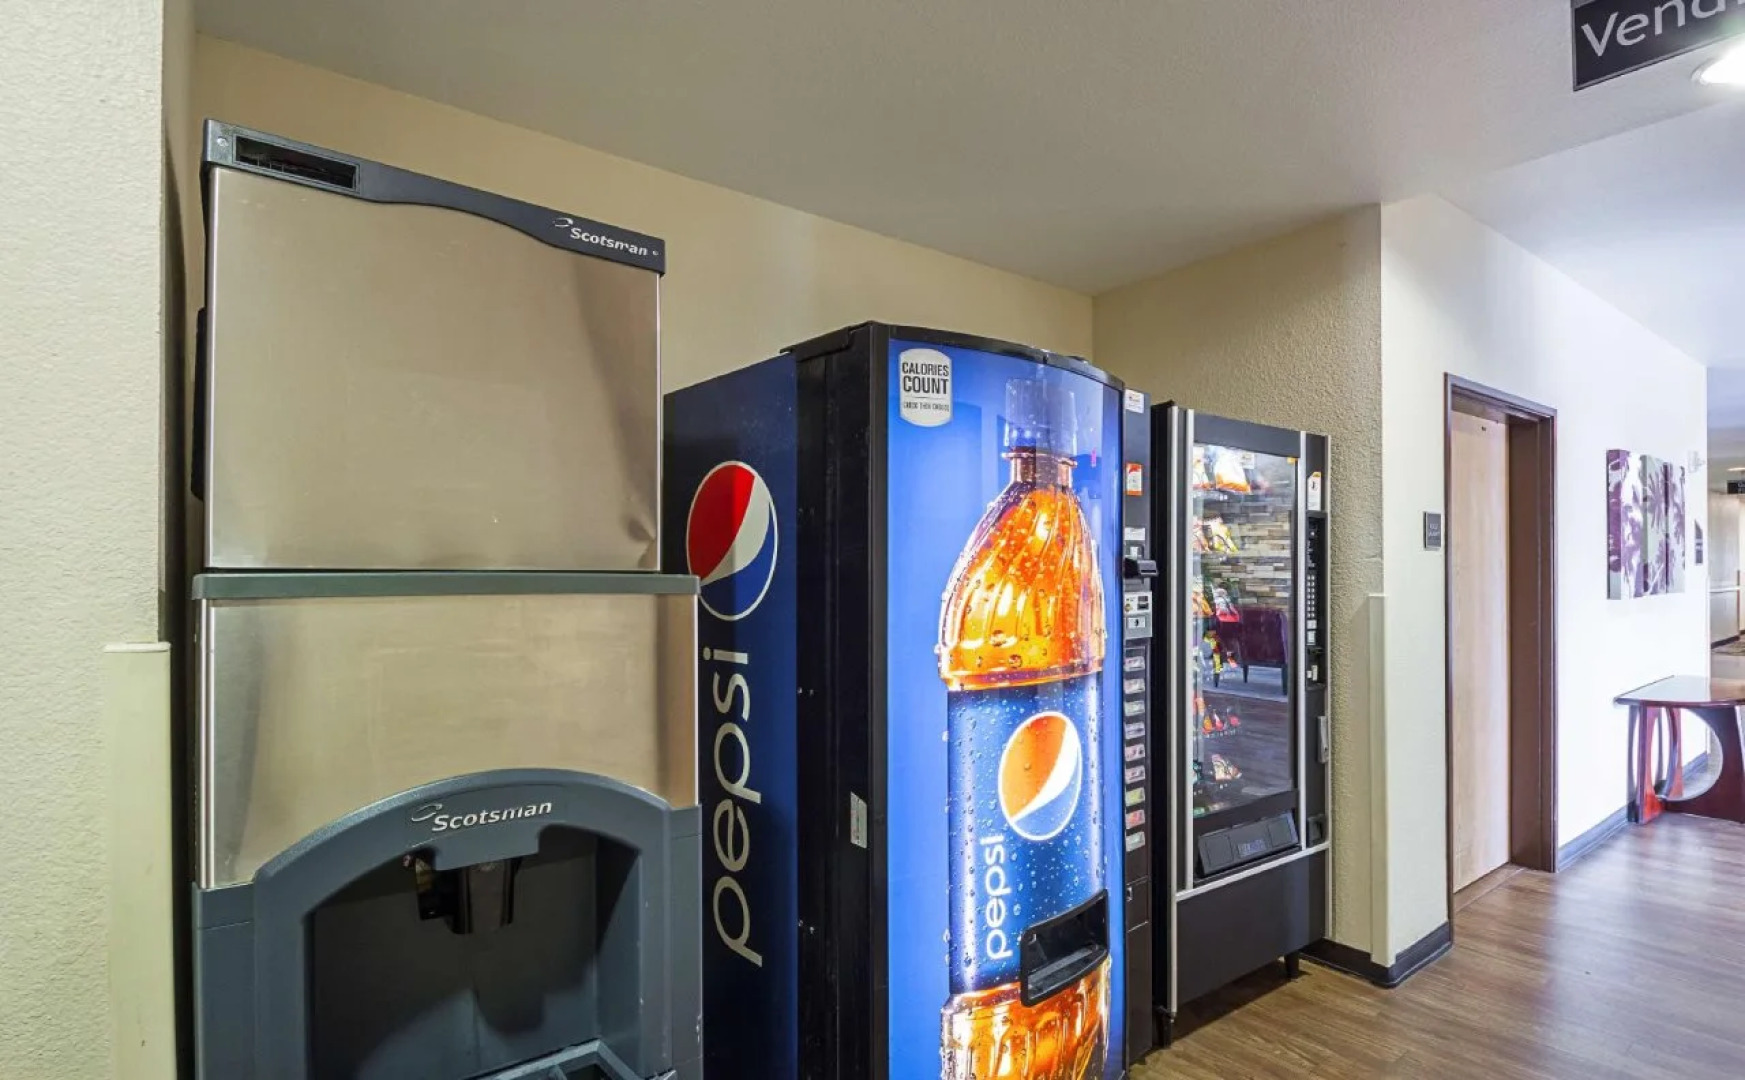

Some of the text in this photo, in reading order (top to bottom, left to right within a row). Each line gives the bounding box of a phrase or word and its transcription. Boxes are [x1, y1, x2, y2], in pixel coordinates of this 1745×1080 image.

[1581, 0, 1745, 57] Ven
[570, 227, 648, 256] Scotsman
[902, 362, 949, 377] CALORIES
[903, 375, 949, 394] COUNT
[432, 802, 552, 831] Scotsman
[703, 647, 762, 967] pepsi
[979, 834, 1013, 960] pepsi
